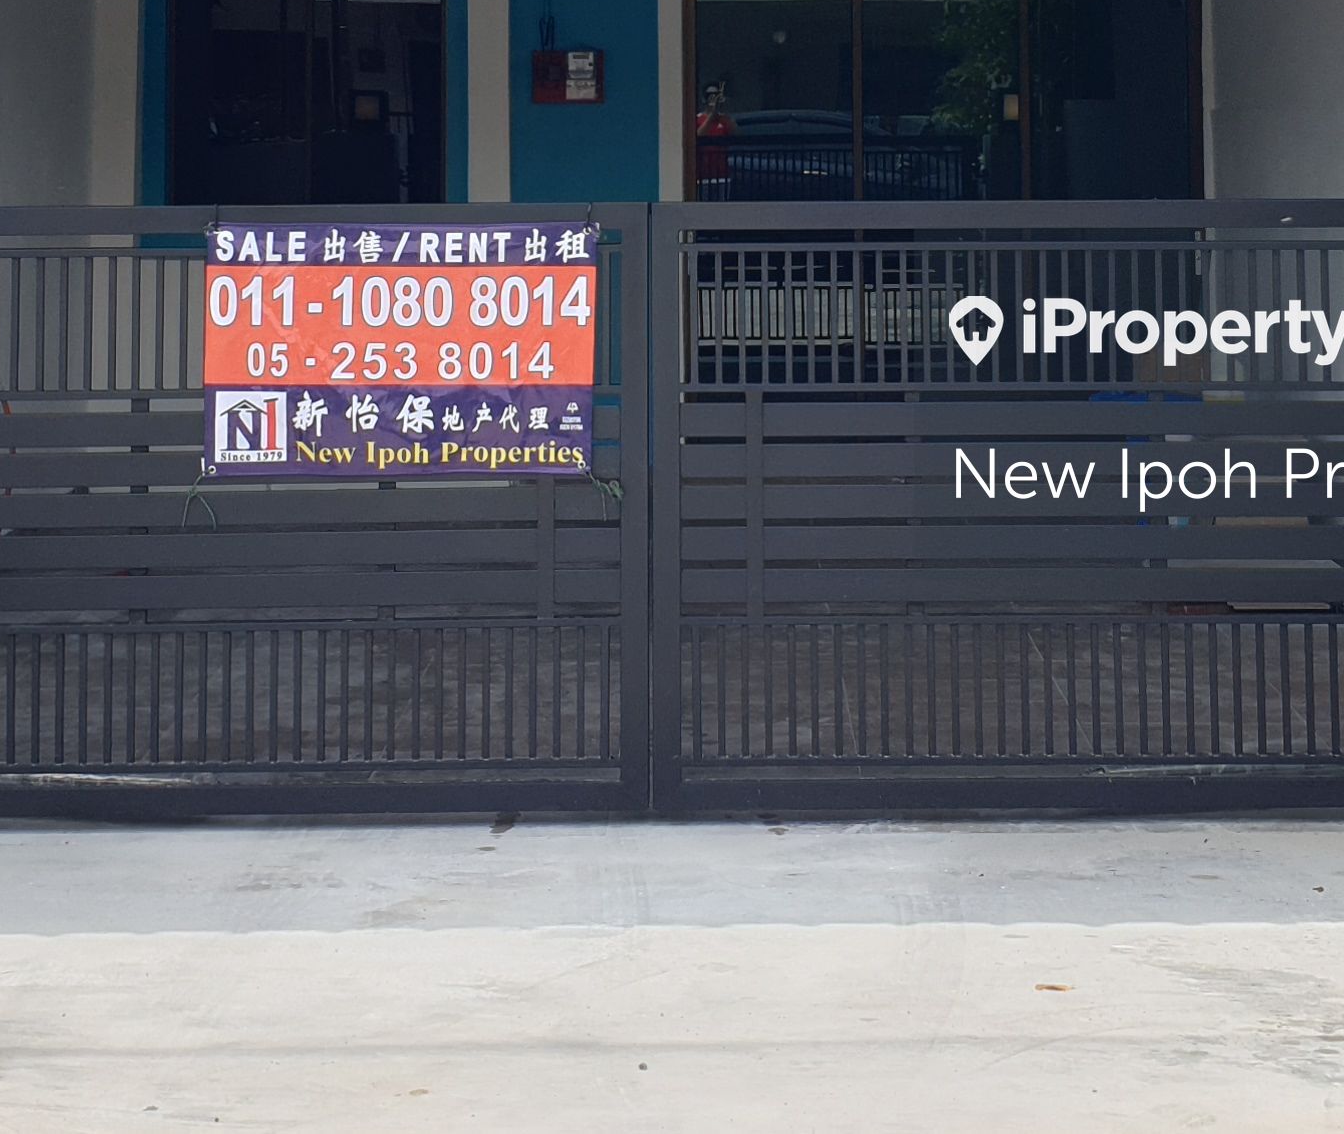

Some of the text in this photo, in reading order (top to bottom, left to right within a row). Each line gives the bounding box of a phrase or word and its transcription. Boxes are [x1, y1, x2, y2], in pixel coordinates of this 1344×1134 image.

[215, 231, 306, 262] SALE
[524, 228, 591, 264] 出租
[469, 275, 591, 327] 8014
[438, 341, 555, 380] 8014
[220, 450, 284, 462] Since 1979
[296, 439, 584, 470] New Ipoh Properties
